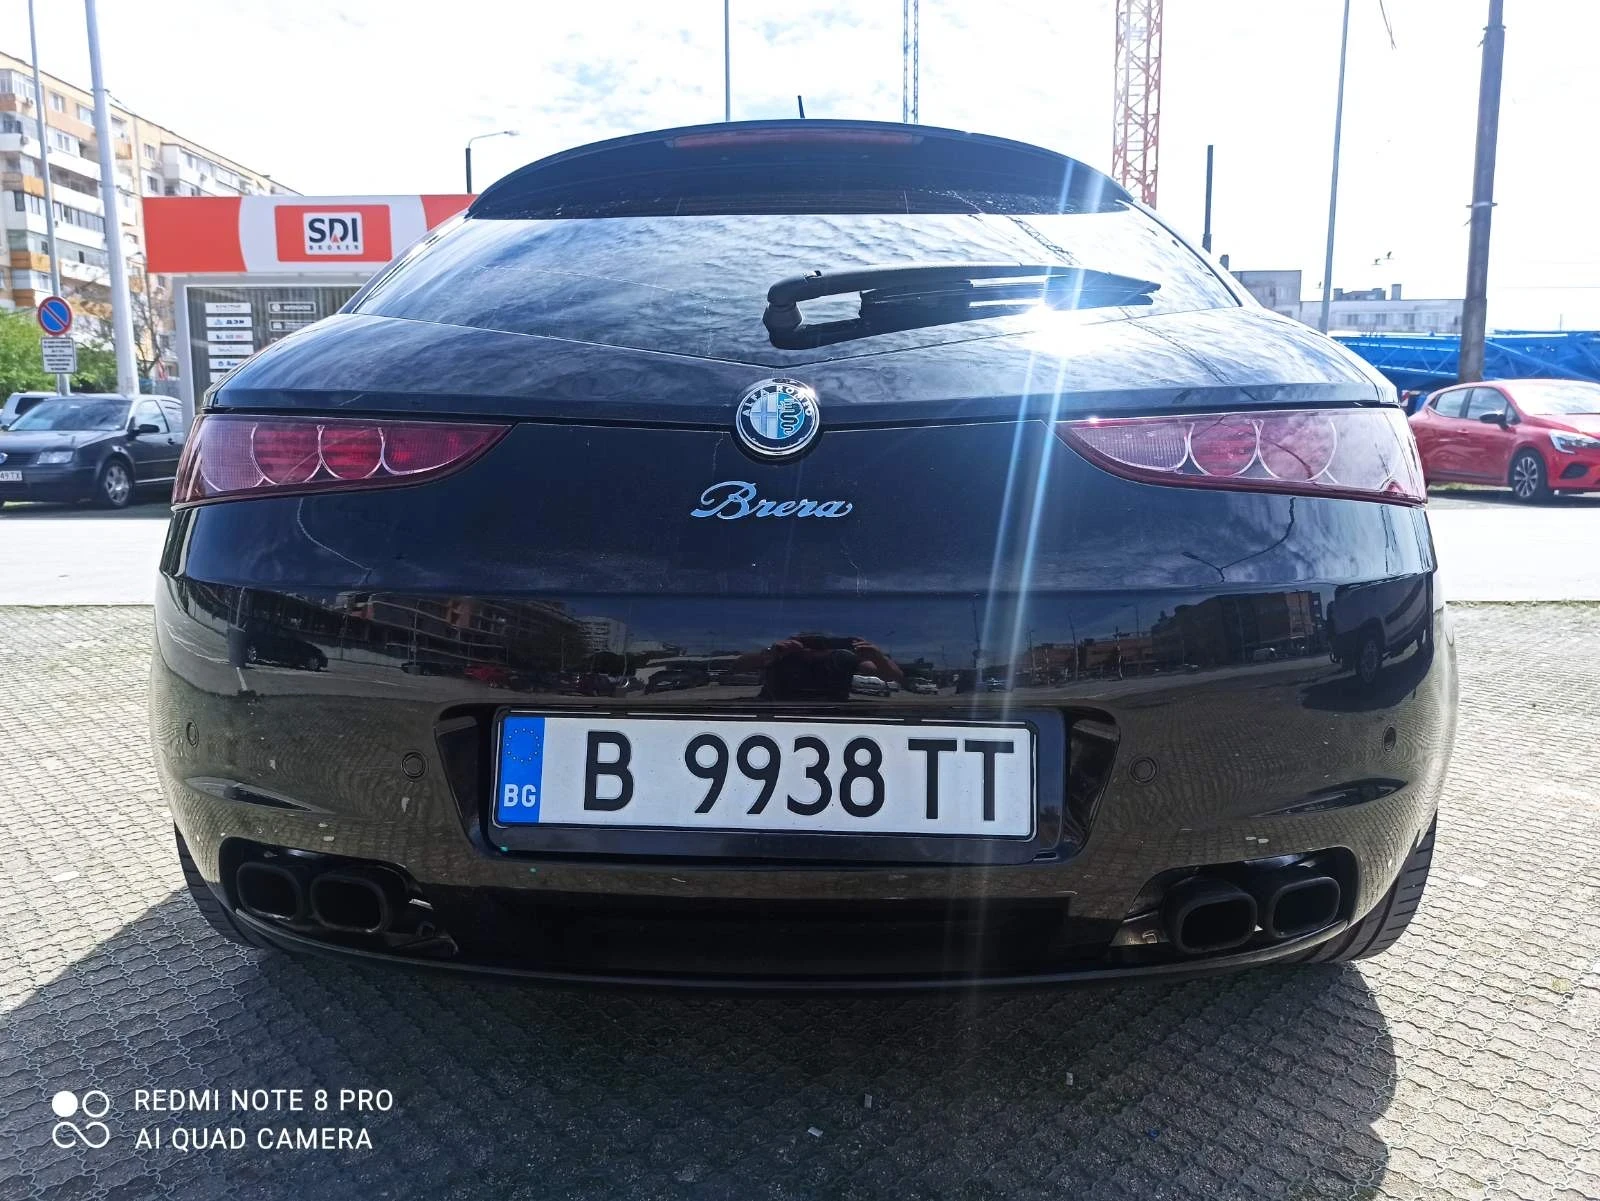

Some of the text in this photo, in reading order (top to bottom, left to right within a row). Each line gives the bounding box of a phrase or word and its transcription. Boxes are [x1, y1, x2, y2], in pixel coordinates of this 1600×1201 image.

[308, 217, 358, 243] SDI
[742, 385, 813, 417] ALFA ROMEO
[690, 480, 853, 520] Brera
[583, 730, 1015, 822] B 9938 TT
[504, 783, 537, 808] BG
